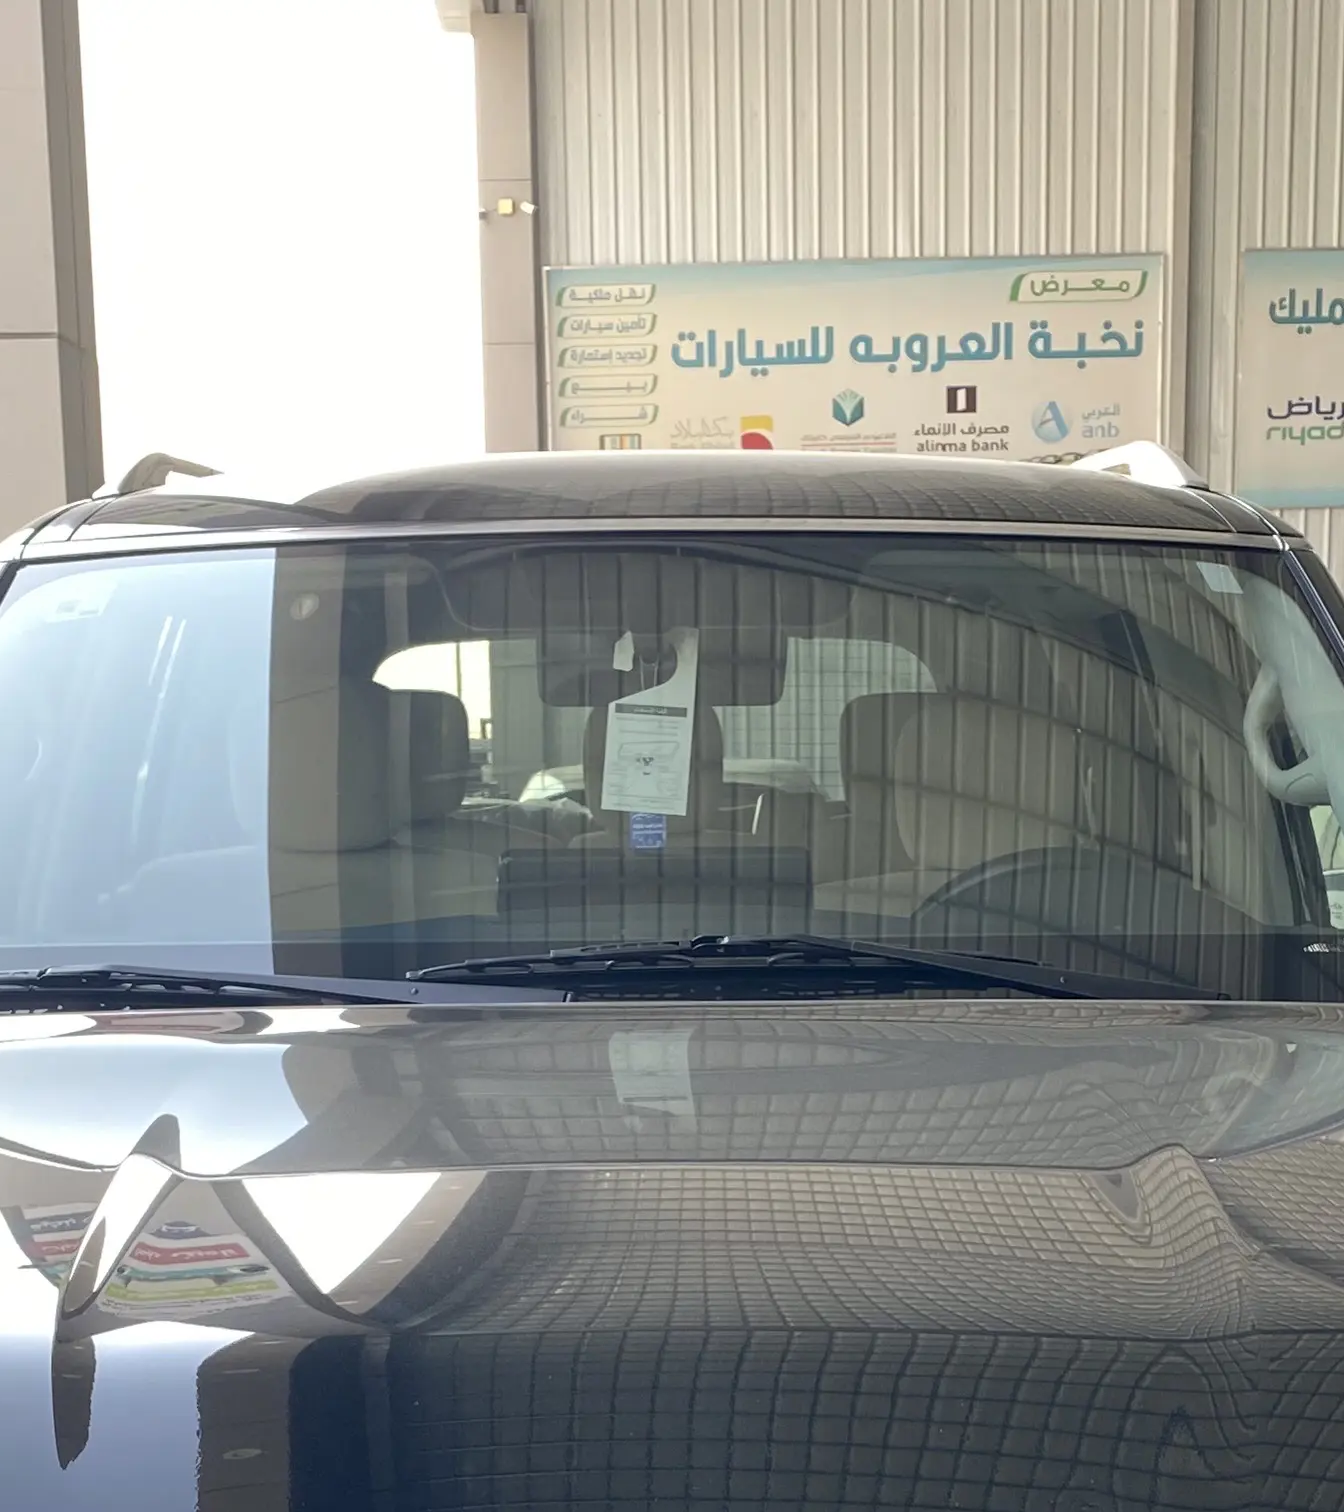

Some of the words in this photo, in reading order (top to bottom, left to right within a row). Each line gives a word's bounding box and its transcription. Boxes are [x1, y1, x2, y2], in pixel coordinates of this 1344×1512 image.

[1030, 274, 1130, 296] معرض
[671, 326, 834, 378] للسيارات
[849, 321, 1014, 374] العروبه
[1027, 320, 1144, 370] نخبة
[960, 422, 1010, 437] مصرف
[1081, 422, 1120, 439] anb
[916, 439, 967, 452] alinma
[971, 438, 1009, 452] bank
